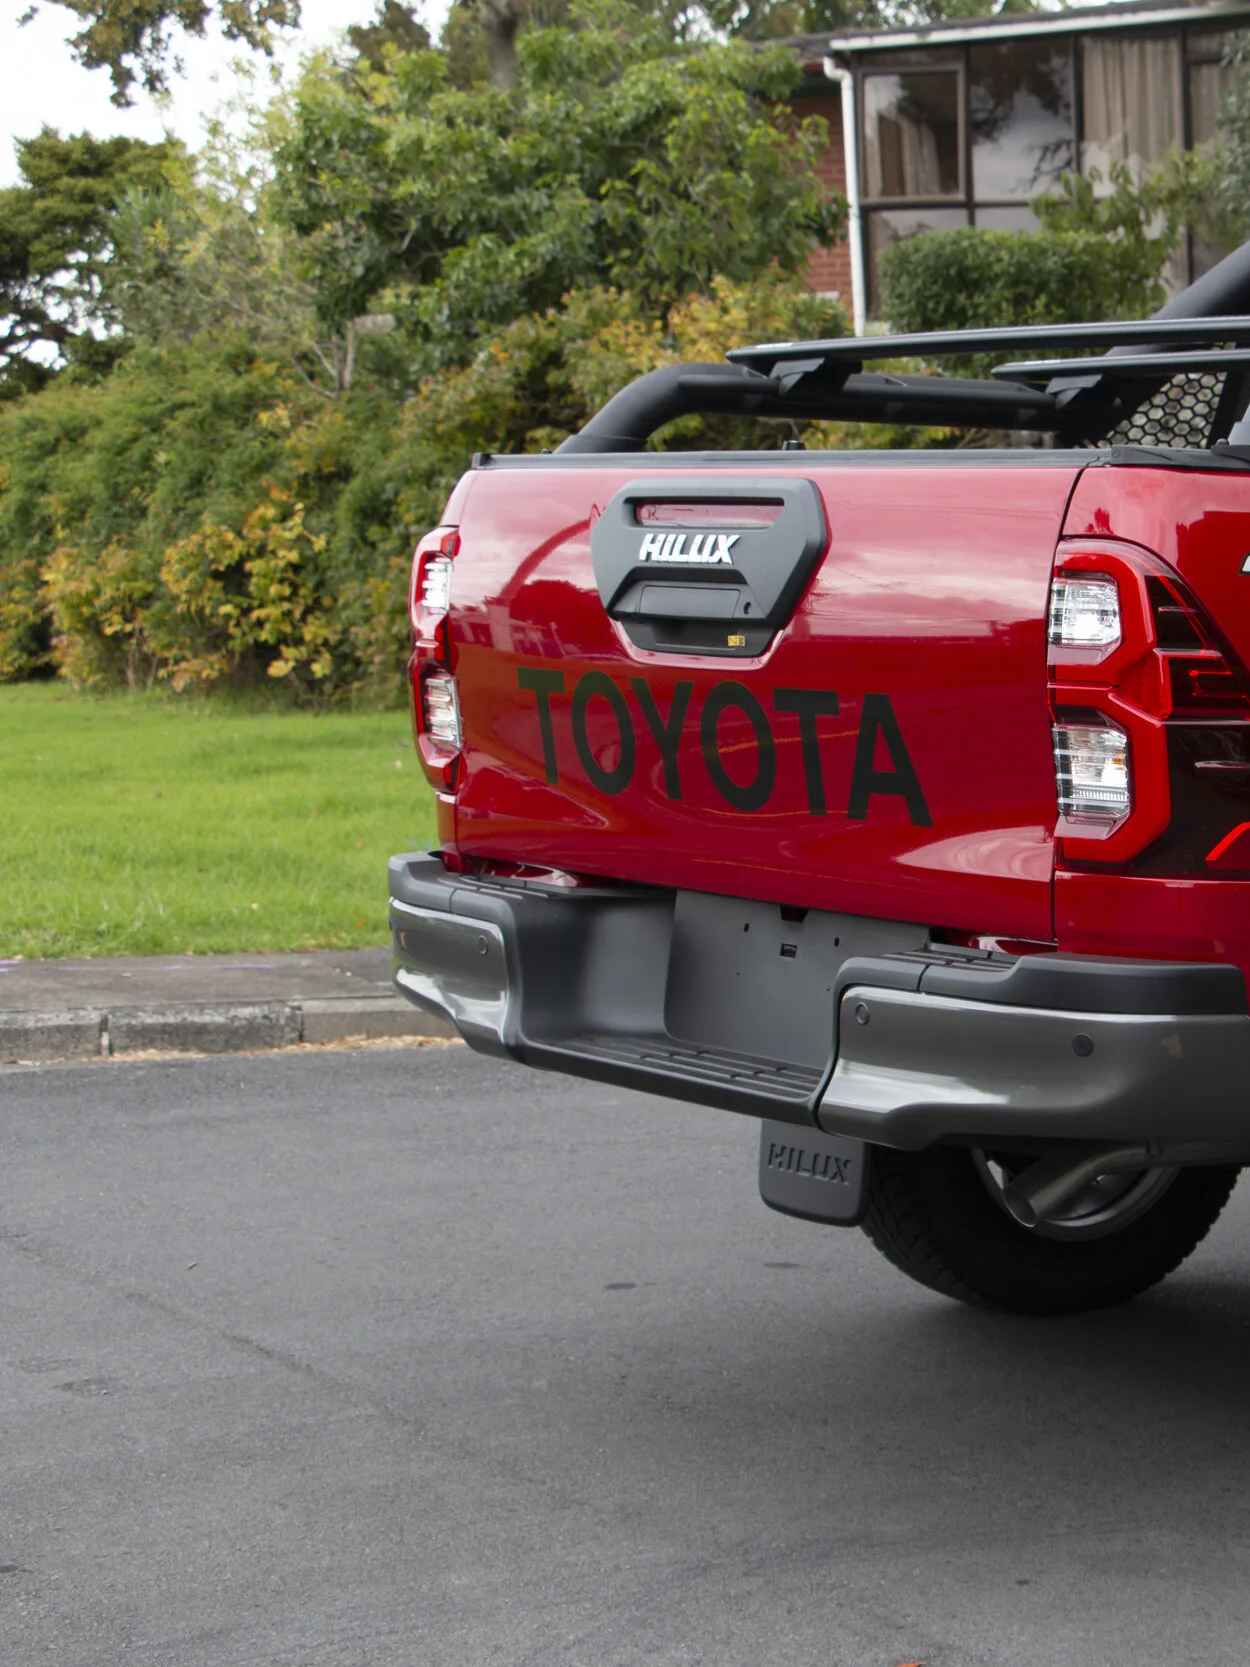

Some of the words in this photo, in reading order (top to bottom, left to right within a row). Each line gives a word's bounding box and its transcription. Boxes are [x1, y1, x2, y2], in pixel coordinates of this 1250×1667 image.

[638, 533, 741, 565] HILUX
[516, 666, 933, 828] TOYOTA
[768, 1143, 851, 1185] HILUX
